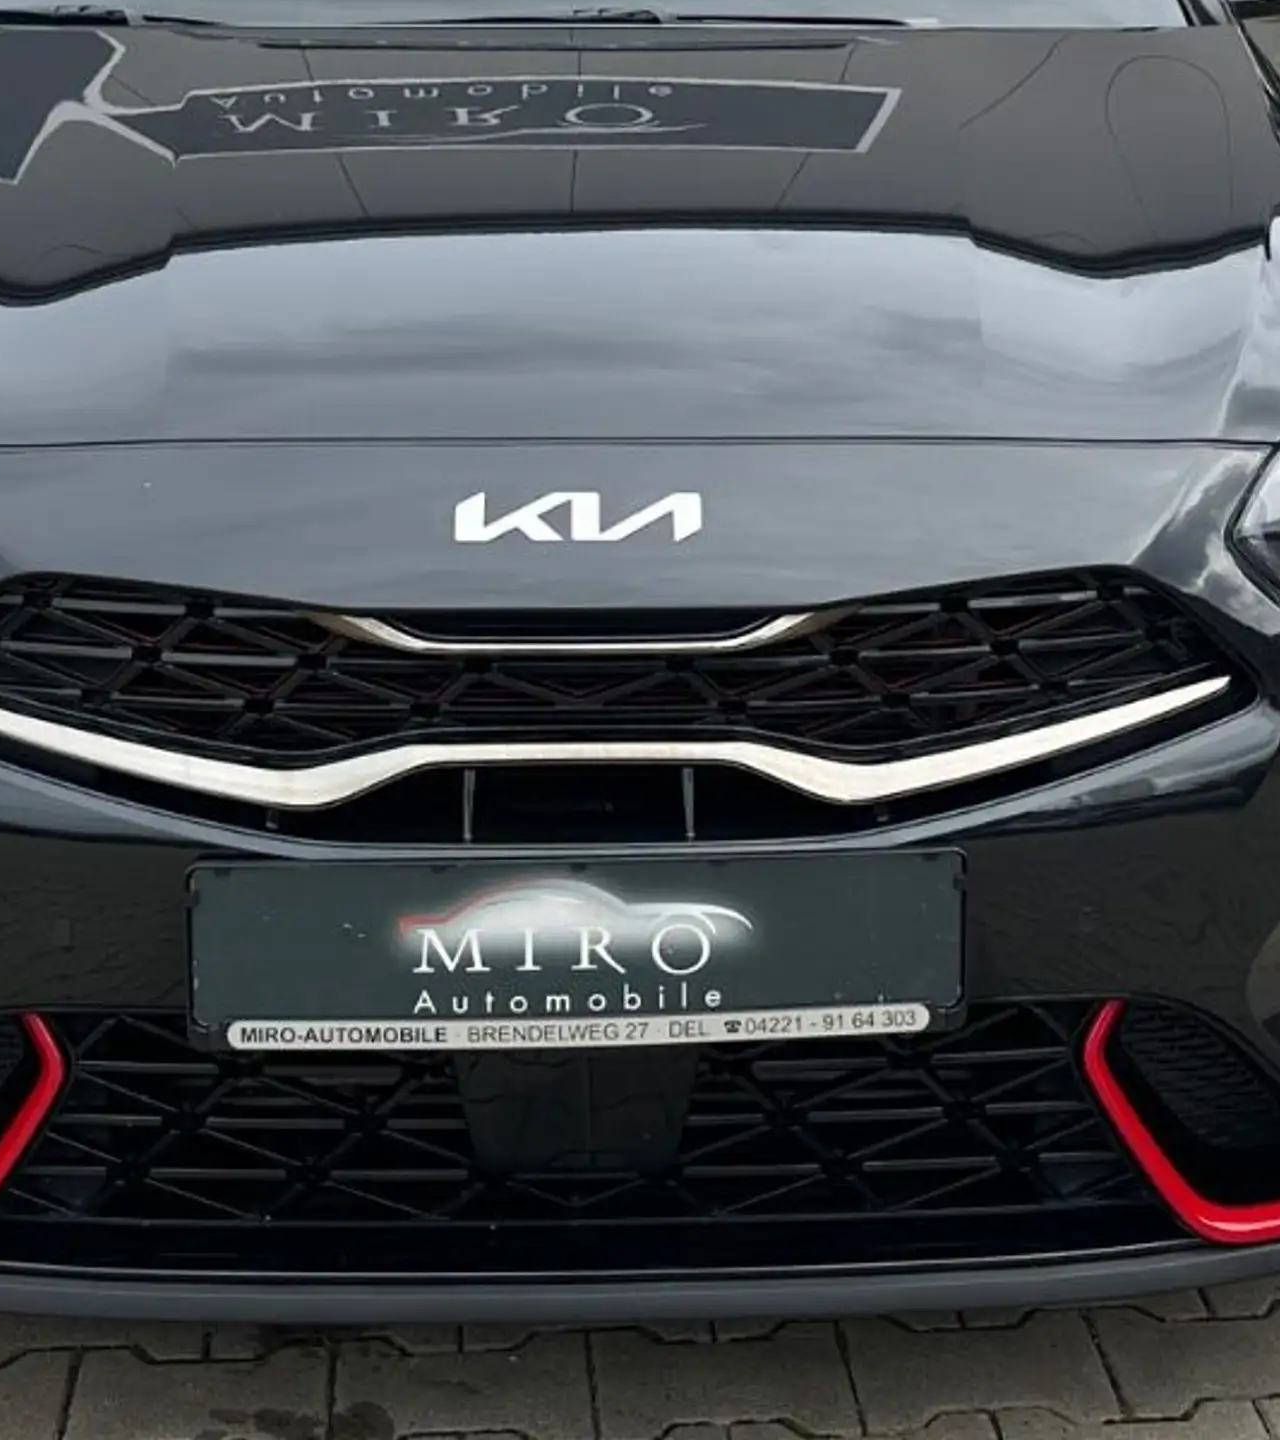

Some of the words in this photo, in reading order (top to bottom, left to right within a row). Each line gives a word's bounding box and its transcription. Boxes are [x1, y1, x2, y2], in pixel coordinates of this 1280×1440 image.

[454, 491, 702, 542] KIA
[413, 923, 711, 975] MIRO
[414, 980, 721, 1014] Automobile
[240, 1026, 448, 1044] MIRO-AUTOMOBILE
[467, 1022, 619, 1044] BRENDELWEG
[625, 1022, 649, 1039] 27
[669, 1019, 710, 1039] DEL
[745, 1015, 803, 1034] 04221
[823, 1013, 844, 1031] 91
[851, 1011, 874, 1029] 64
[882, 1009, 917, 1027] 303
